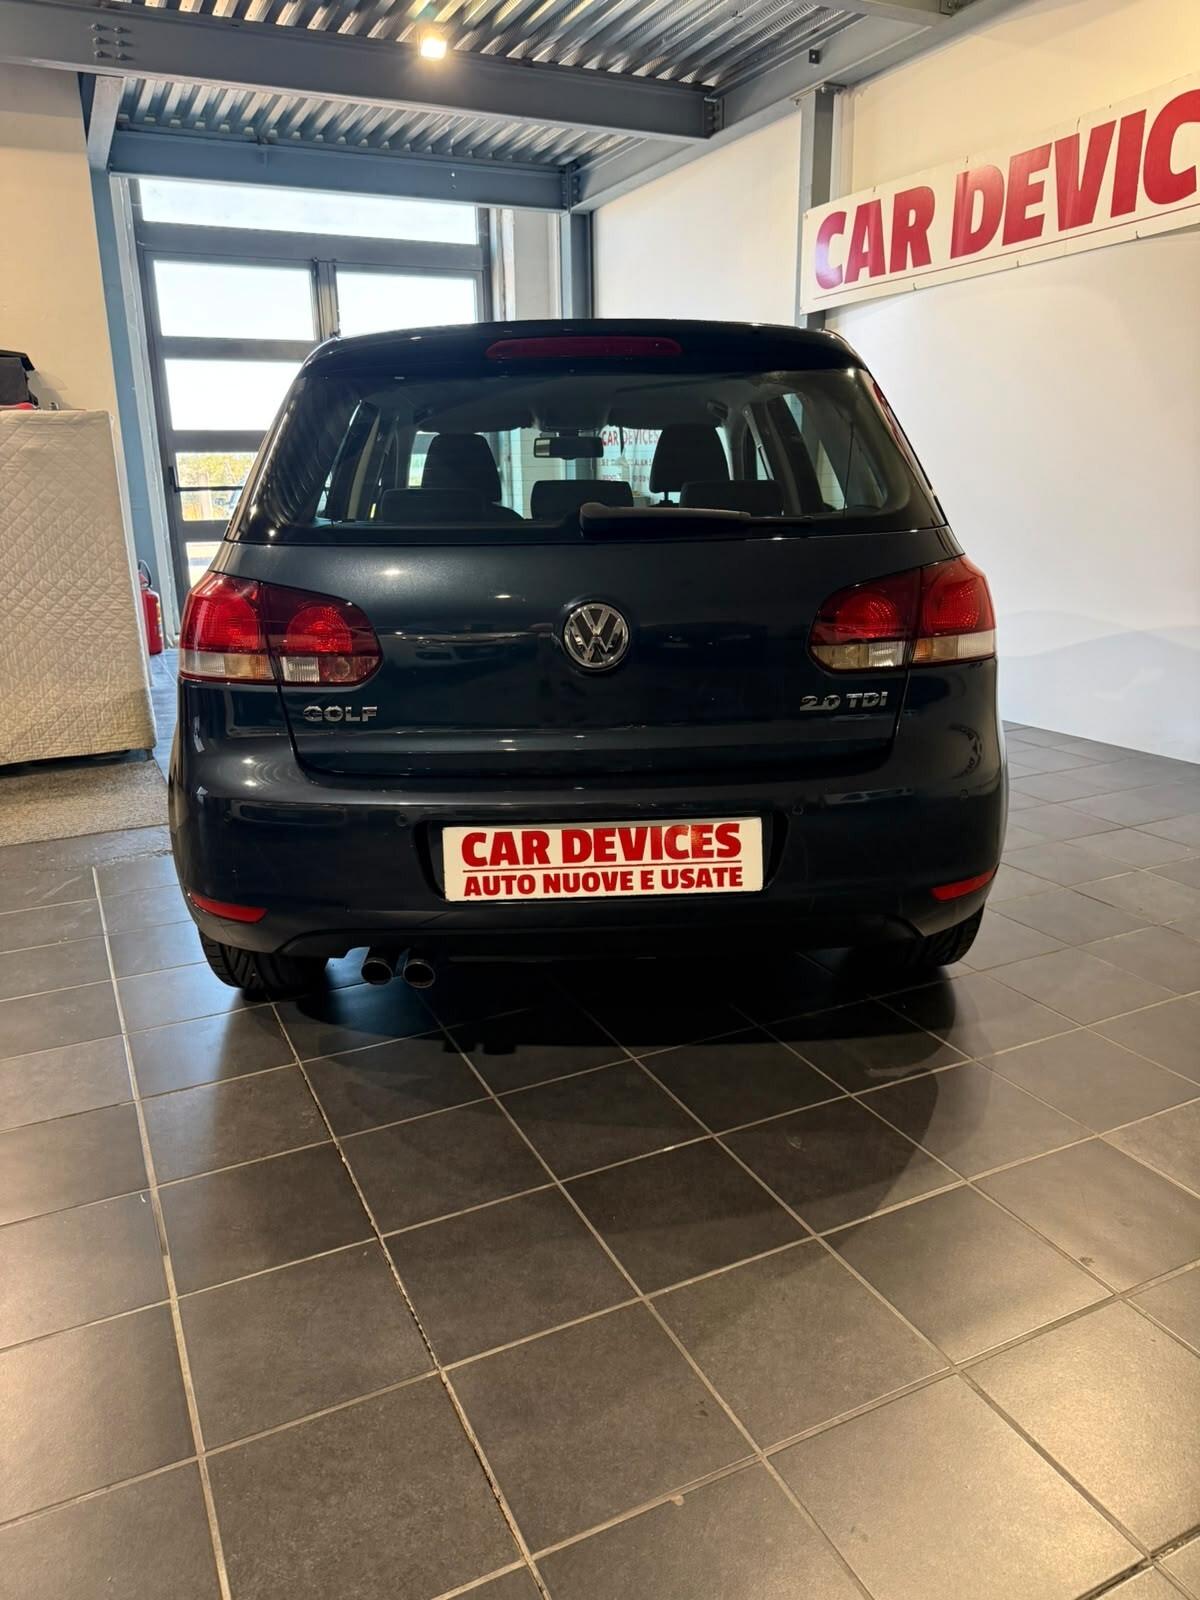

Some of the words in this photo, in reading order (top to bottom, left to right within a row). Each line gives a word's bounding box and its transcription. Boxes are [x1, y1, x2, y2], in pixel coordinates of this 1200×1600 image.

[815, 185, 936, 290] CAR
[601, 430, 619, 446] CAR
[846, 691, 889, 708] TDI
[303, 705, 378, 722] GOLF
[461, 830, 551, 867] CAR
[561, 822, 742, 864] DEVICES
[463, 873, 536, 897] AUTO
[542, 870, 634, 893] NUOVE
[640, 869, 655, 890] E
[660, 866, 743, 889] USATE
